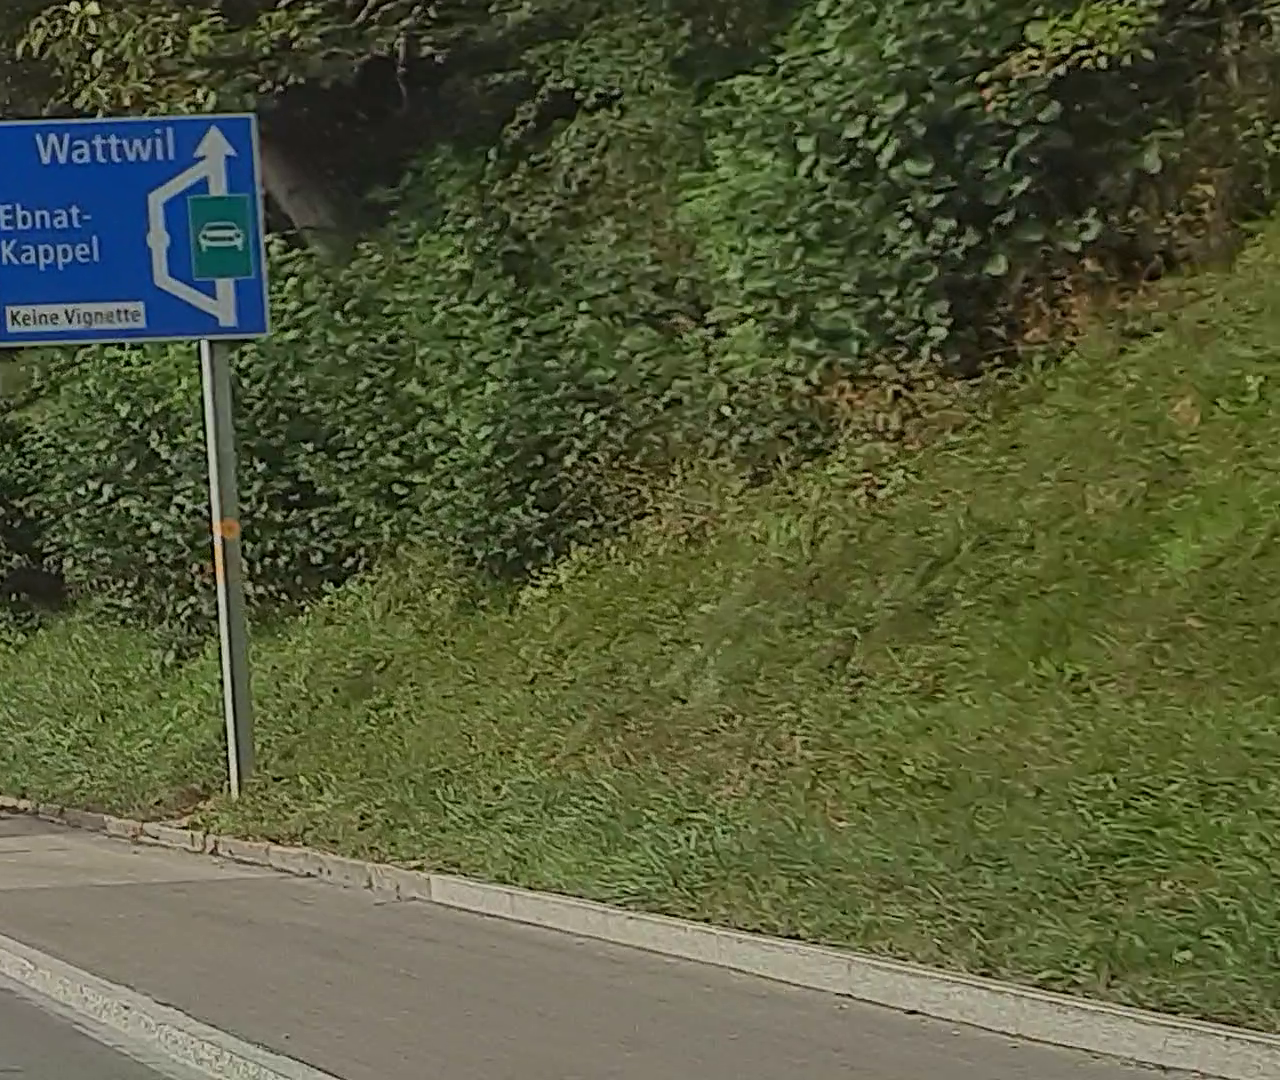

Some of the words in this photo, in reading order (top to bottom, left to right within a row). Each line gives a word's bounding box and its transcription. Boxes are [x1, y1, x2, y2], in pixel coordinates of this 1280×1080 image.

[36, 127, 175, 164] Wattwil
[1, 235, 100, 271] Kappel
[10, 310, 59, 327] Keine
[64, 308, 141, 328] Vignette
